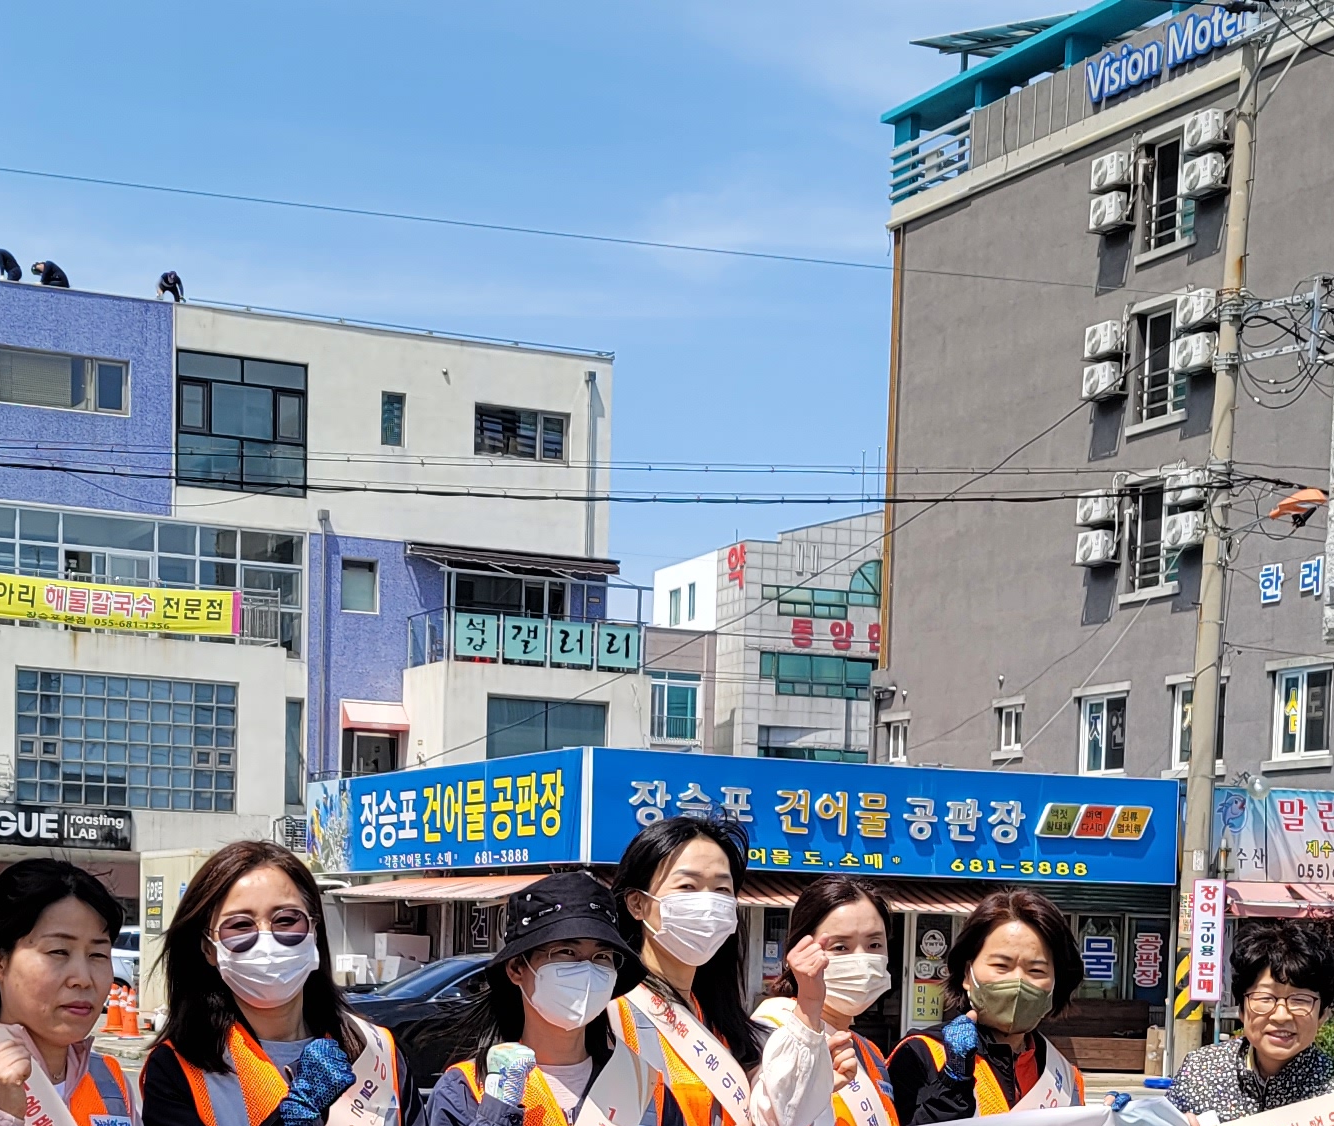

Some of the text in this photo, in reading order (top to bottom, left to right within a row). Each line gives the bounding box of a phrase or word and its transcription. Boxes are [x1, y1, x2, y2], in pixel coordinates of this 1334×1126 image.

[1086, 3, 1251, 102] Vision Motel
[727, 543, 747, 589] 약
[43, 583, 157, 619] 해물칼국수
[162, 597, 224, 622] 전문점
[511, 623, 631, 660] 갤러리
[69, 813, 125, 829] roasting
[359, 768, 565, 849] 장승포 건어물 공판장
[775, 786, 891, 840] 건어물
[902, 796, 1027, 845] 공판장
[69, 826, 97, 840] LAB
[474, 847, 529, 865] 681-3888
[950, 857, 1088, 877] 681-3888
[1197, 885, 1219, 994] 장어 구이용 판매
[1080, 931, 1164, 988] 물 공판장
[692, 1039, 720, 1072] 사용
